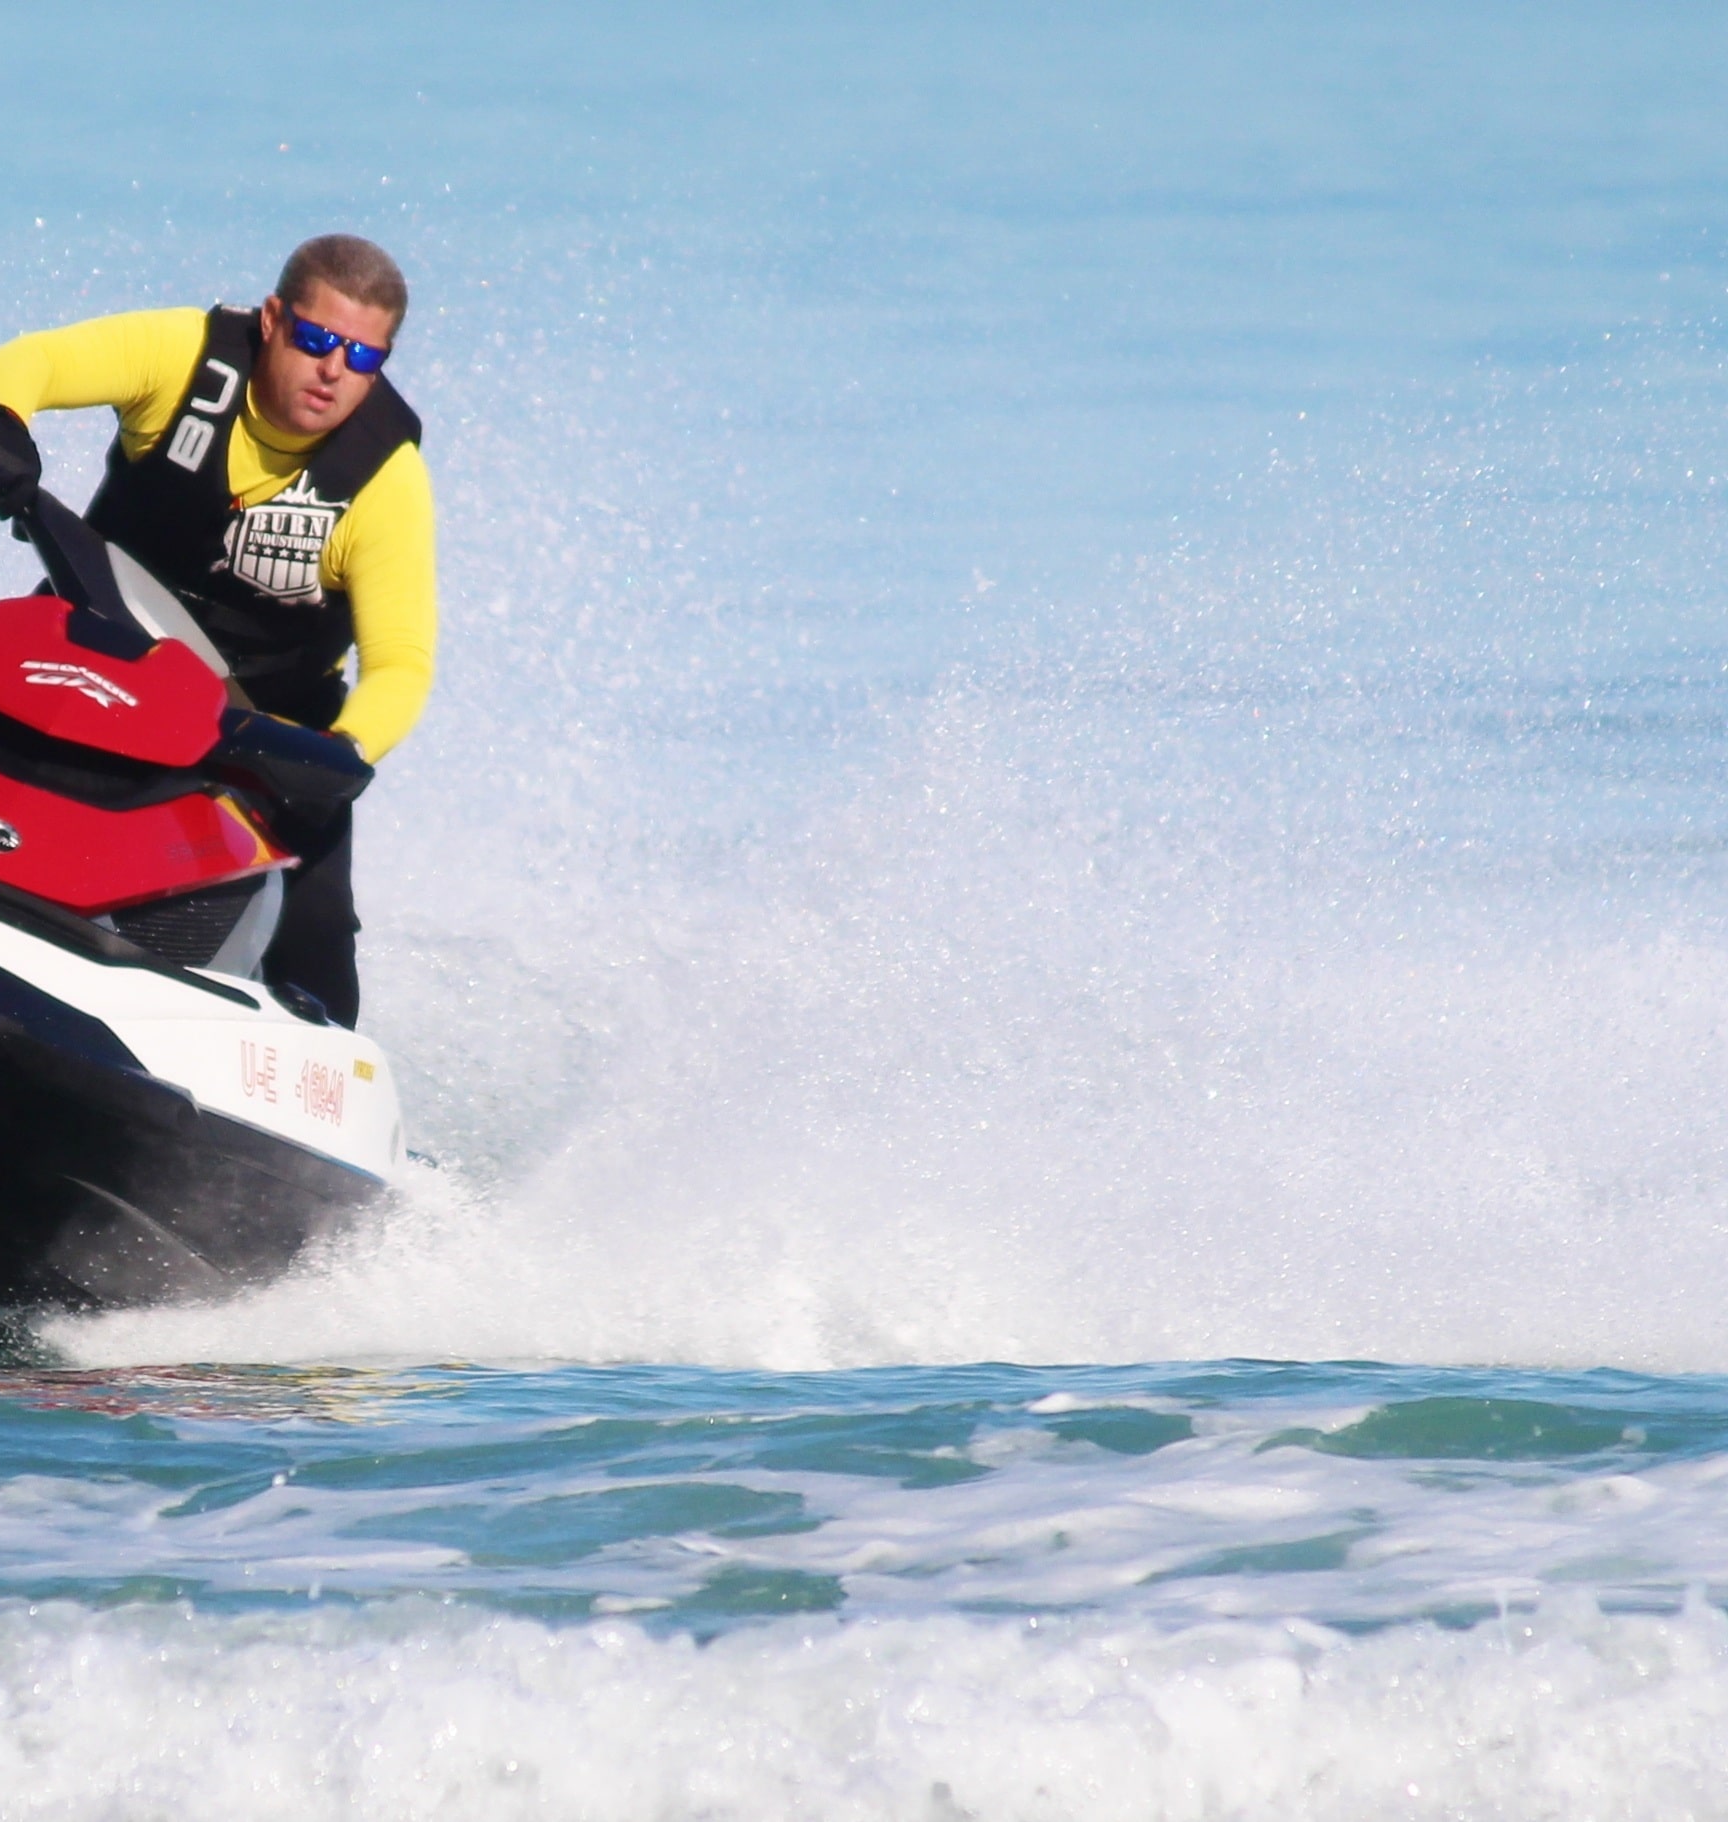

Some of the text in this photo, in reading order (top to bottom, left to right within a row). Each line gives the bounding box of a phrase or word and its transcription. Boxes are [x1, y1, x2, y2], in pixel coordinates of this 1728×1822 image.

[166, 305, 253, 472] BU
[251, 512, 327, 536] BURN
[248, 531, 323, 550] INDUSTRIES
